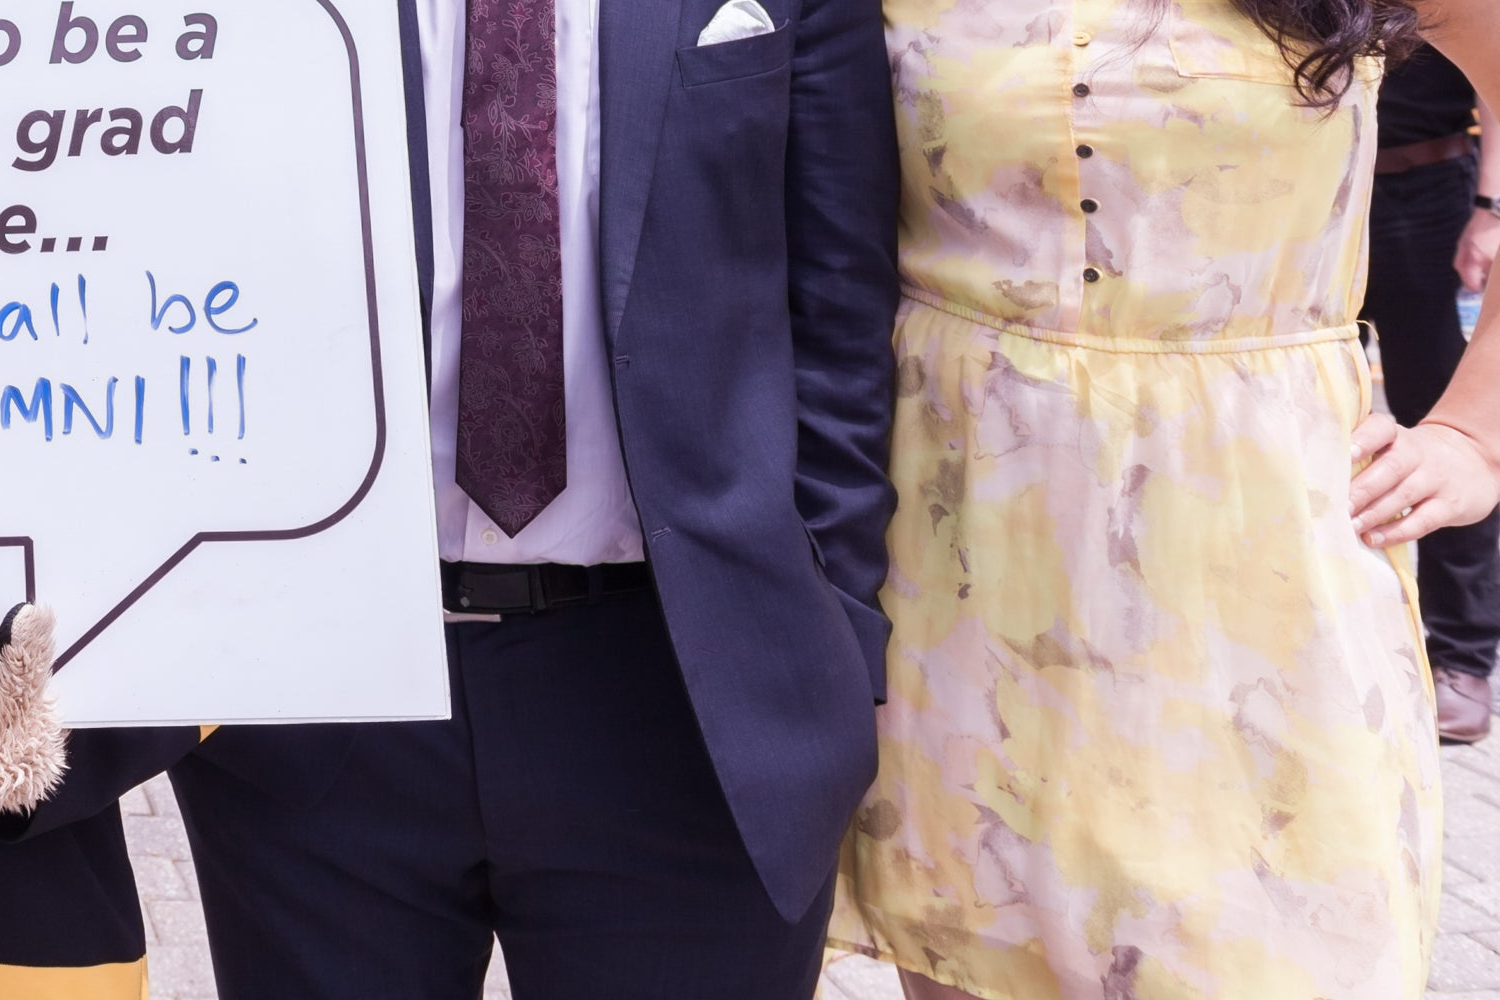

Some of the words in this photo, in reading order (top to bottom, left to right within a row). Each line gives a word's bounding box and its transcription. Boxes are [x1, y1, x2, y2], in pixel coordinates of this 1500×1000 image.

[49, 1, 148, 65] be
[176, 12, 218, 61] a
[12, 89, 204, 172] grad
[146, 272, 259, 335] be
